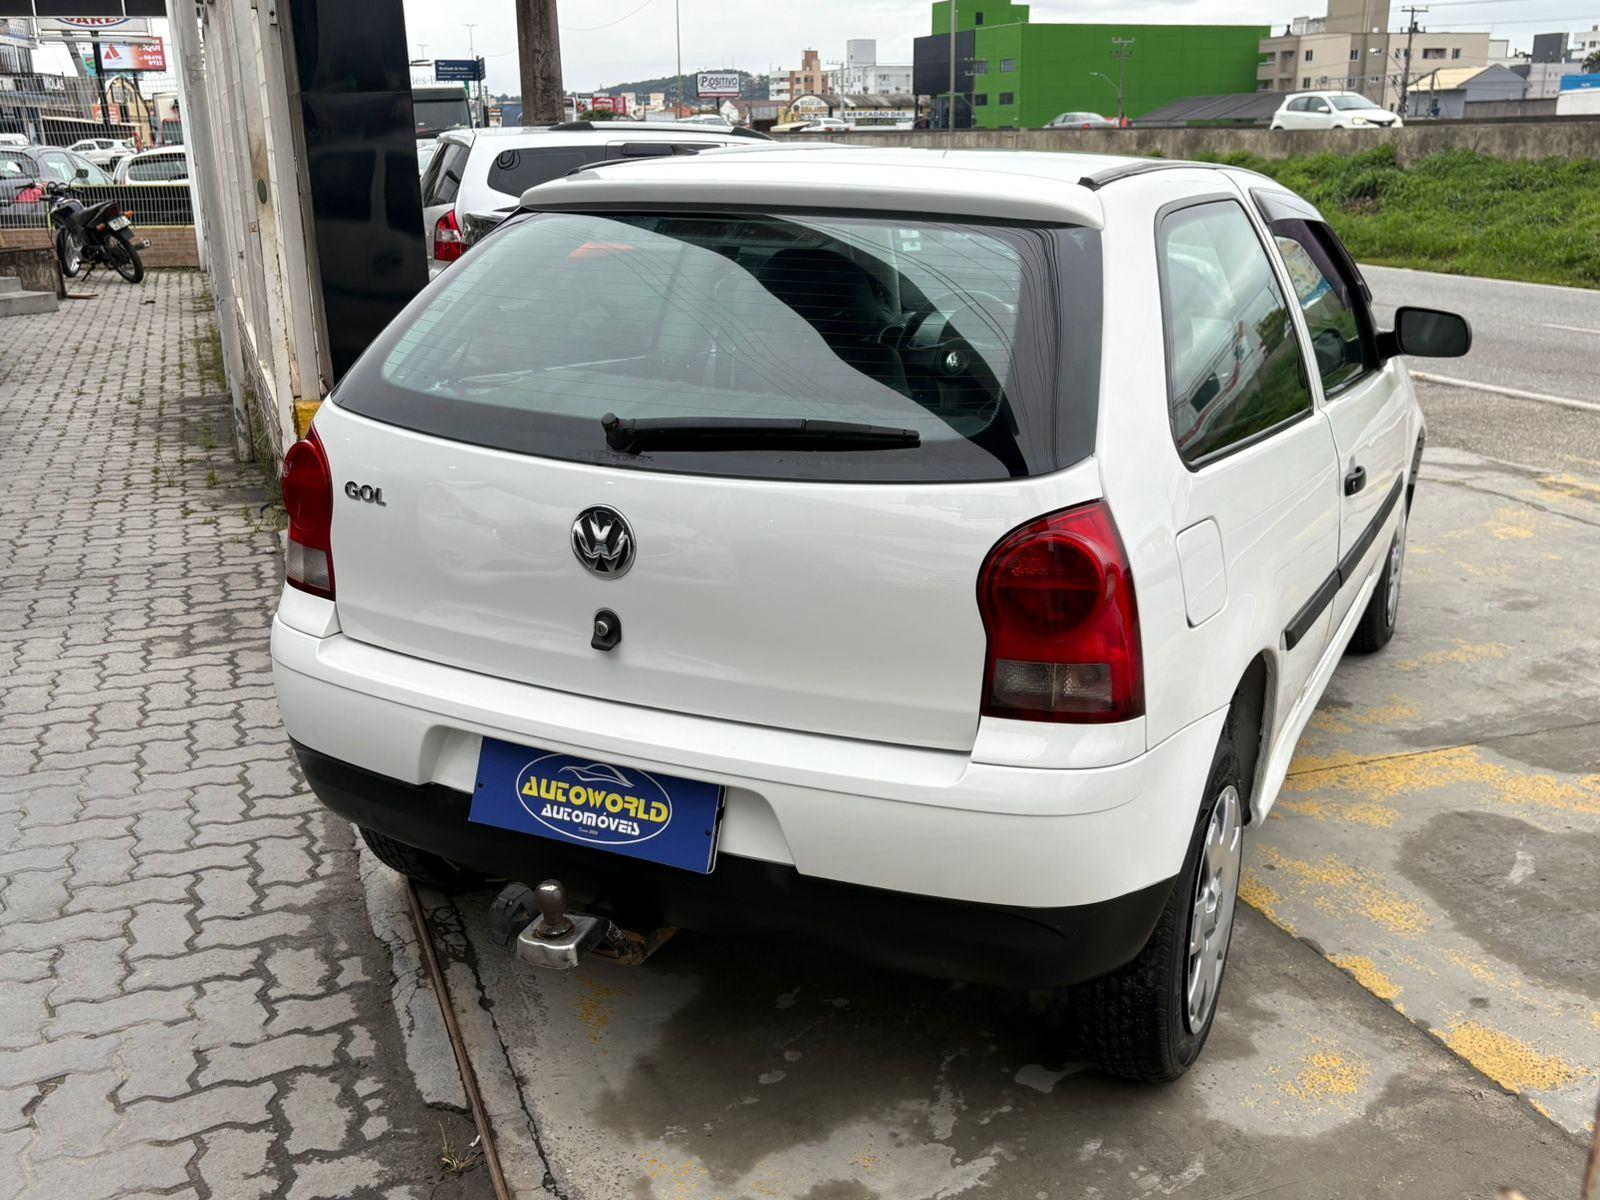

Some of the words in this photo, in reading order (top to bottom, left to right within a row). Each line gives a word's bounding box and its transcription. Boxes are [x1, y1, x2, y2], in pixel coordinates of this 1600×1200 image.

[699, 75, 738, 89] POSITIVO
[344, 480, 387, 507] GOL
[522, 776, 668, 823] AUTOWORLD
